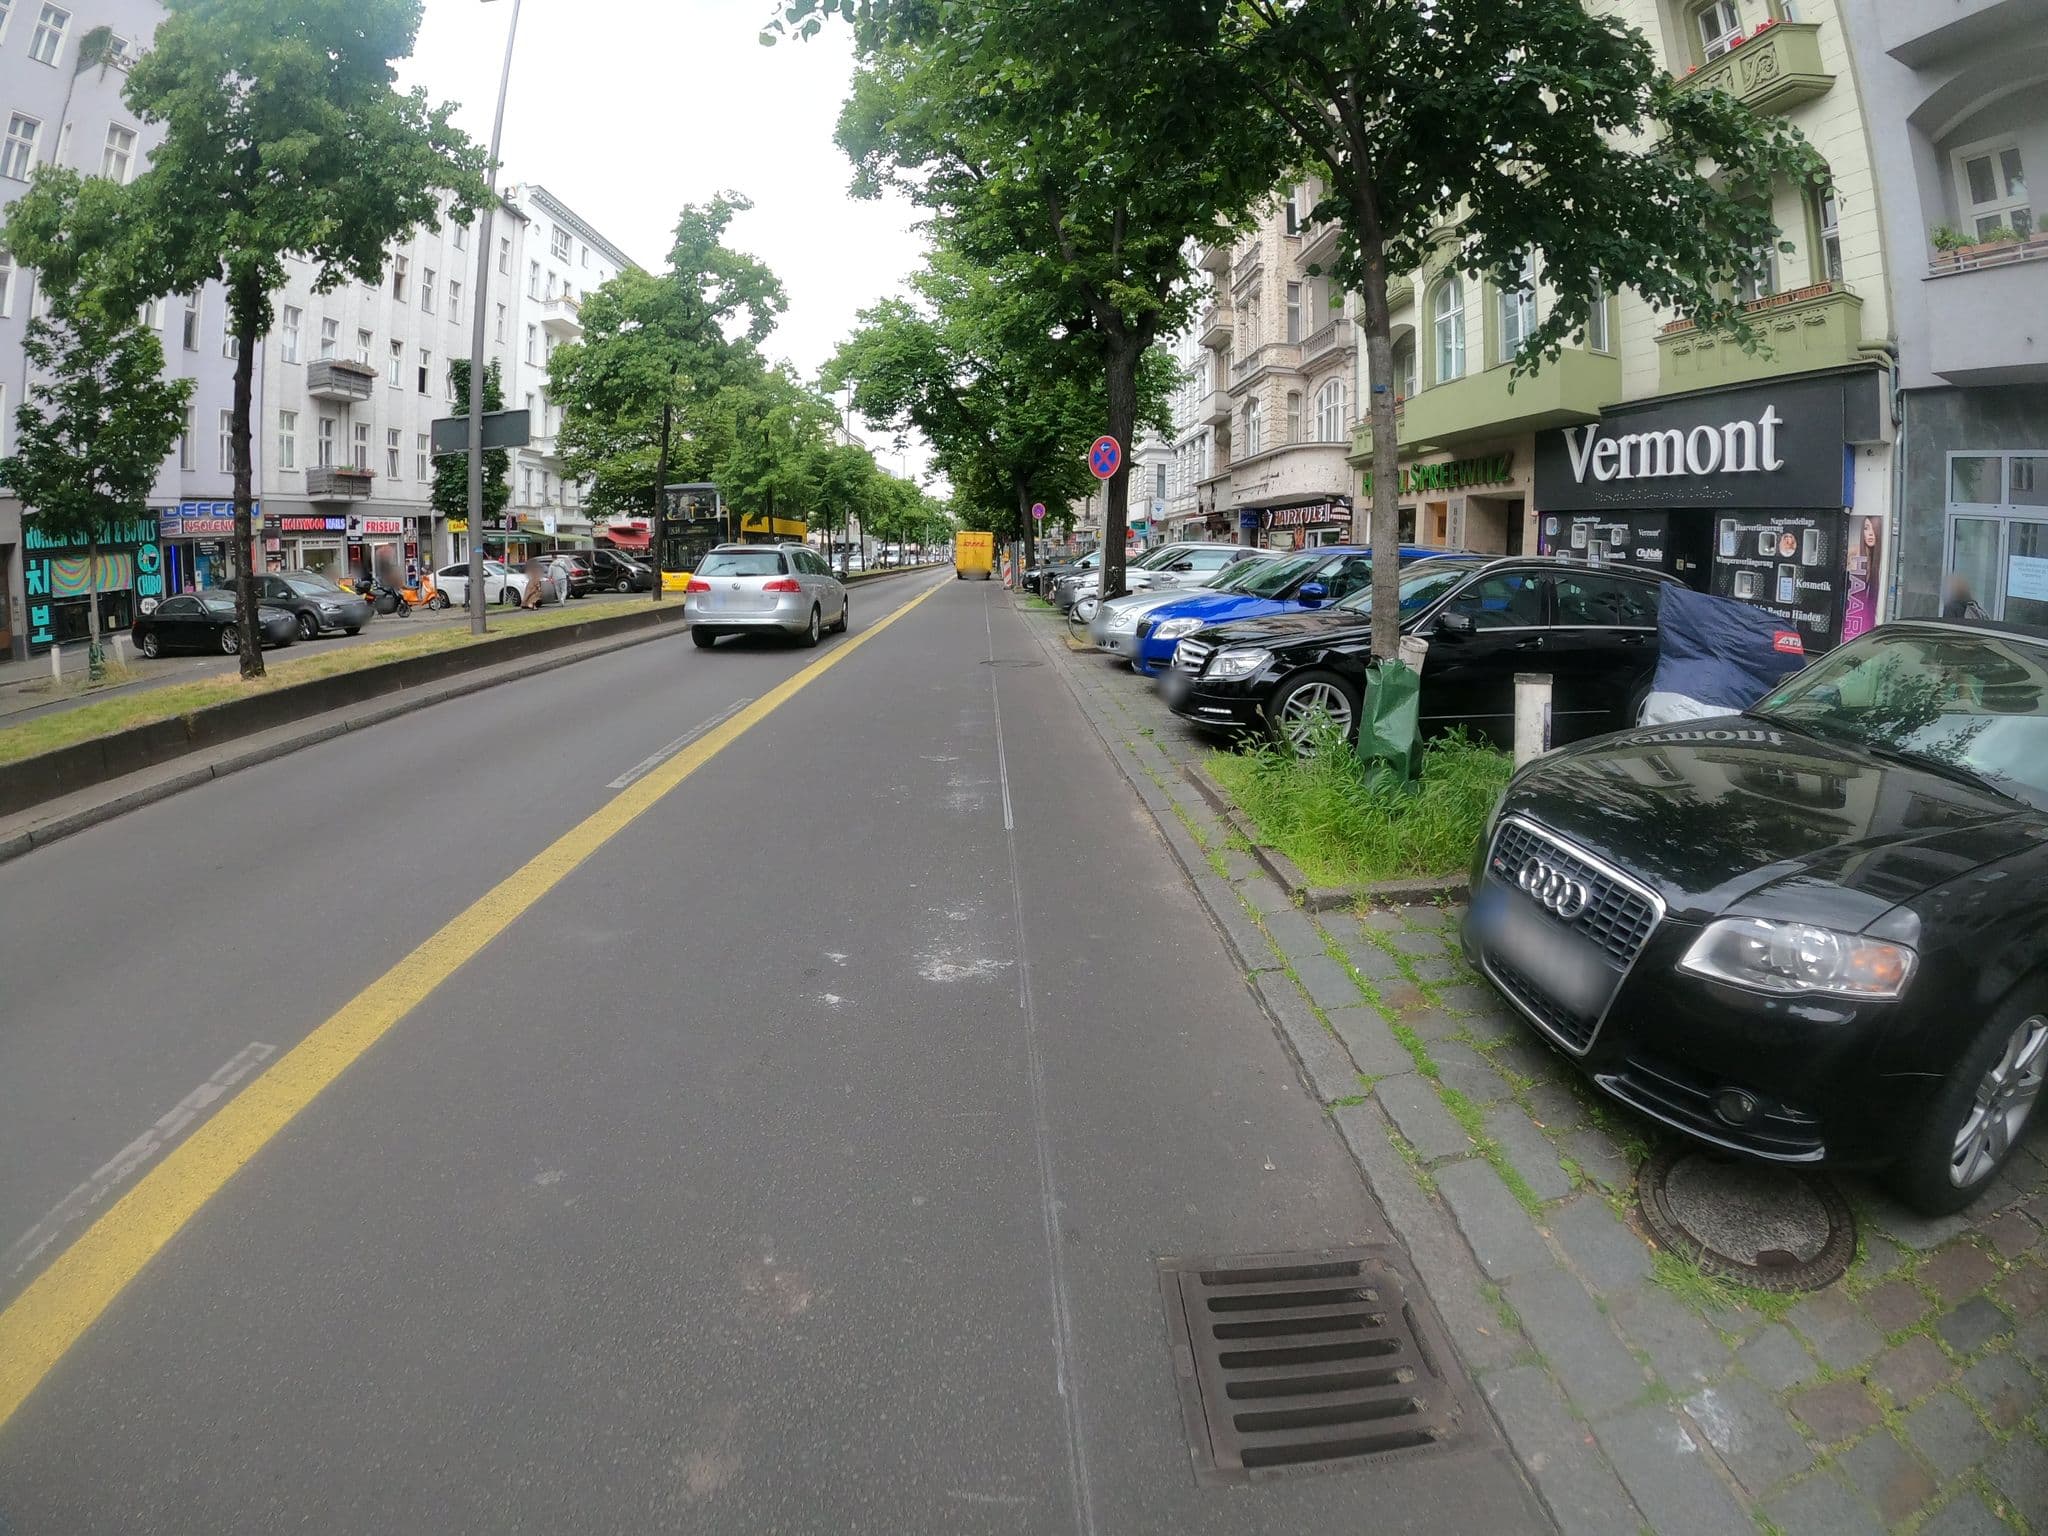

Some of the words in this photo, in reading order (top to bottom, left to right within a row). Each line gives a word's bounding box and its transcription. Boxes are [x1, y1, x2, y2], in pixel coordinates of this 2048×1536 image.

[1562, 404, 1784, 484] Vermont
[281, 518, 325, 530] HOLLYWOOD
[326, 518, 346, 530] NAILS
[366, 521, 400, 532] FRISEUR
[137, 574, 162, 596] CHIBO
[1796, 579, 1832, 591] Kosmetik
[1792, 610, 1821, 622] Händen
